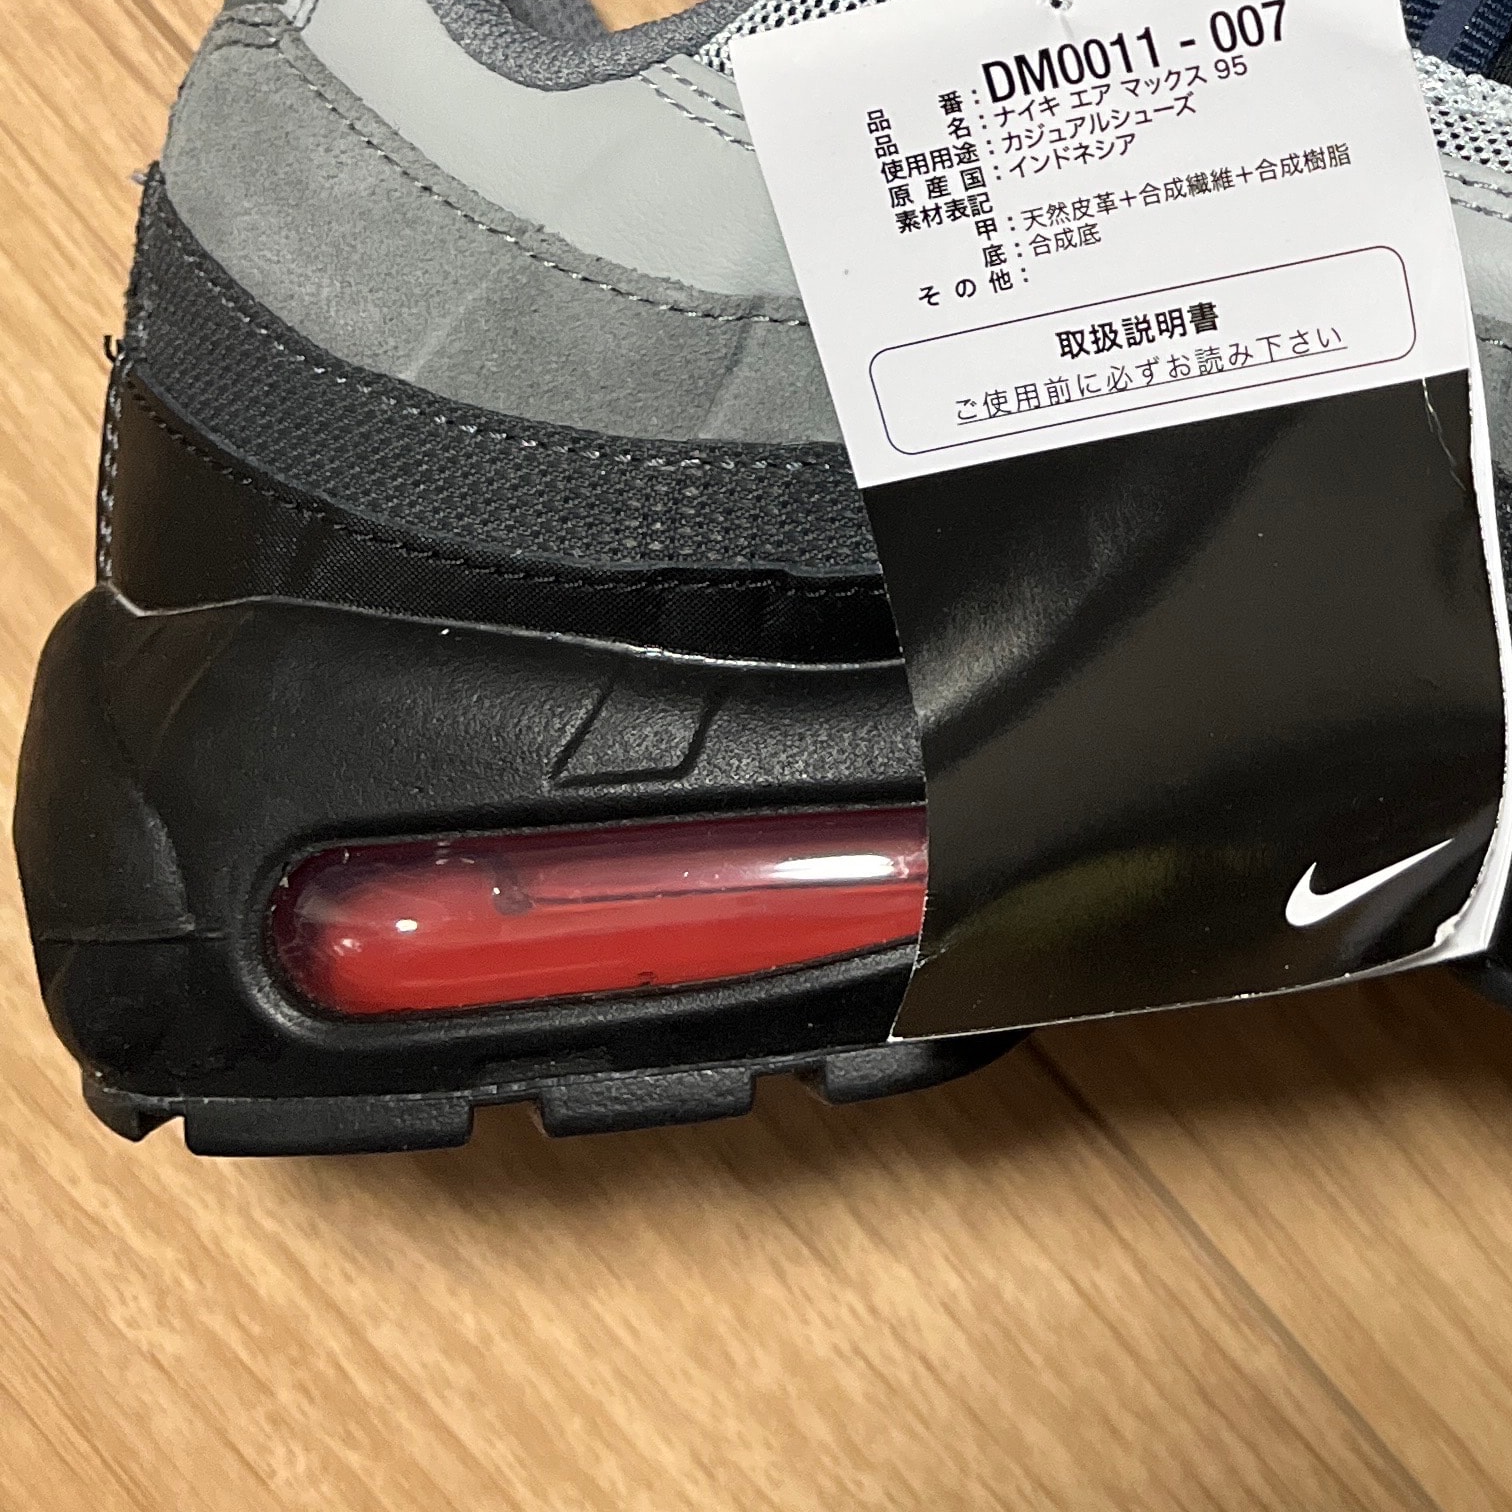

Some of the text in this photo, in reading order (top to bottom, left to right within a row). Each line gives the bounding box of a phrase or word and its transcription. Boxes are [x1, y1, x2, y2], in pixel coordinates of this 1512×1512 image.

[982, 27, 1160, 103] DM0011
[1210, 0, 1285, 52] 007
[994, 96, 1059, 127] ナイキ
[1070, 84, 1110, 108] エア
[1121, 66, 1207, 97] マックス
[1215, 55, 1247, 79] 95
[1002, 91, 1196, 153] カジュアルシューズ
[1010, 134, 1135, 177] インドネシア
[895, 192, 993, 233] 素材表記
[1029, 223, 1101, 256] 合成底
[1055, 302, 1218, 359] 取扱説明書
[956, 328, 1341, 421] ご使用前に必ずお読み下さい
